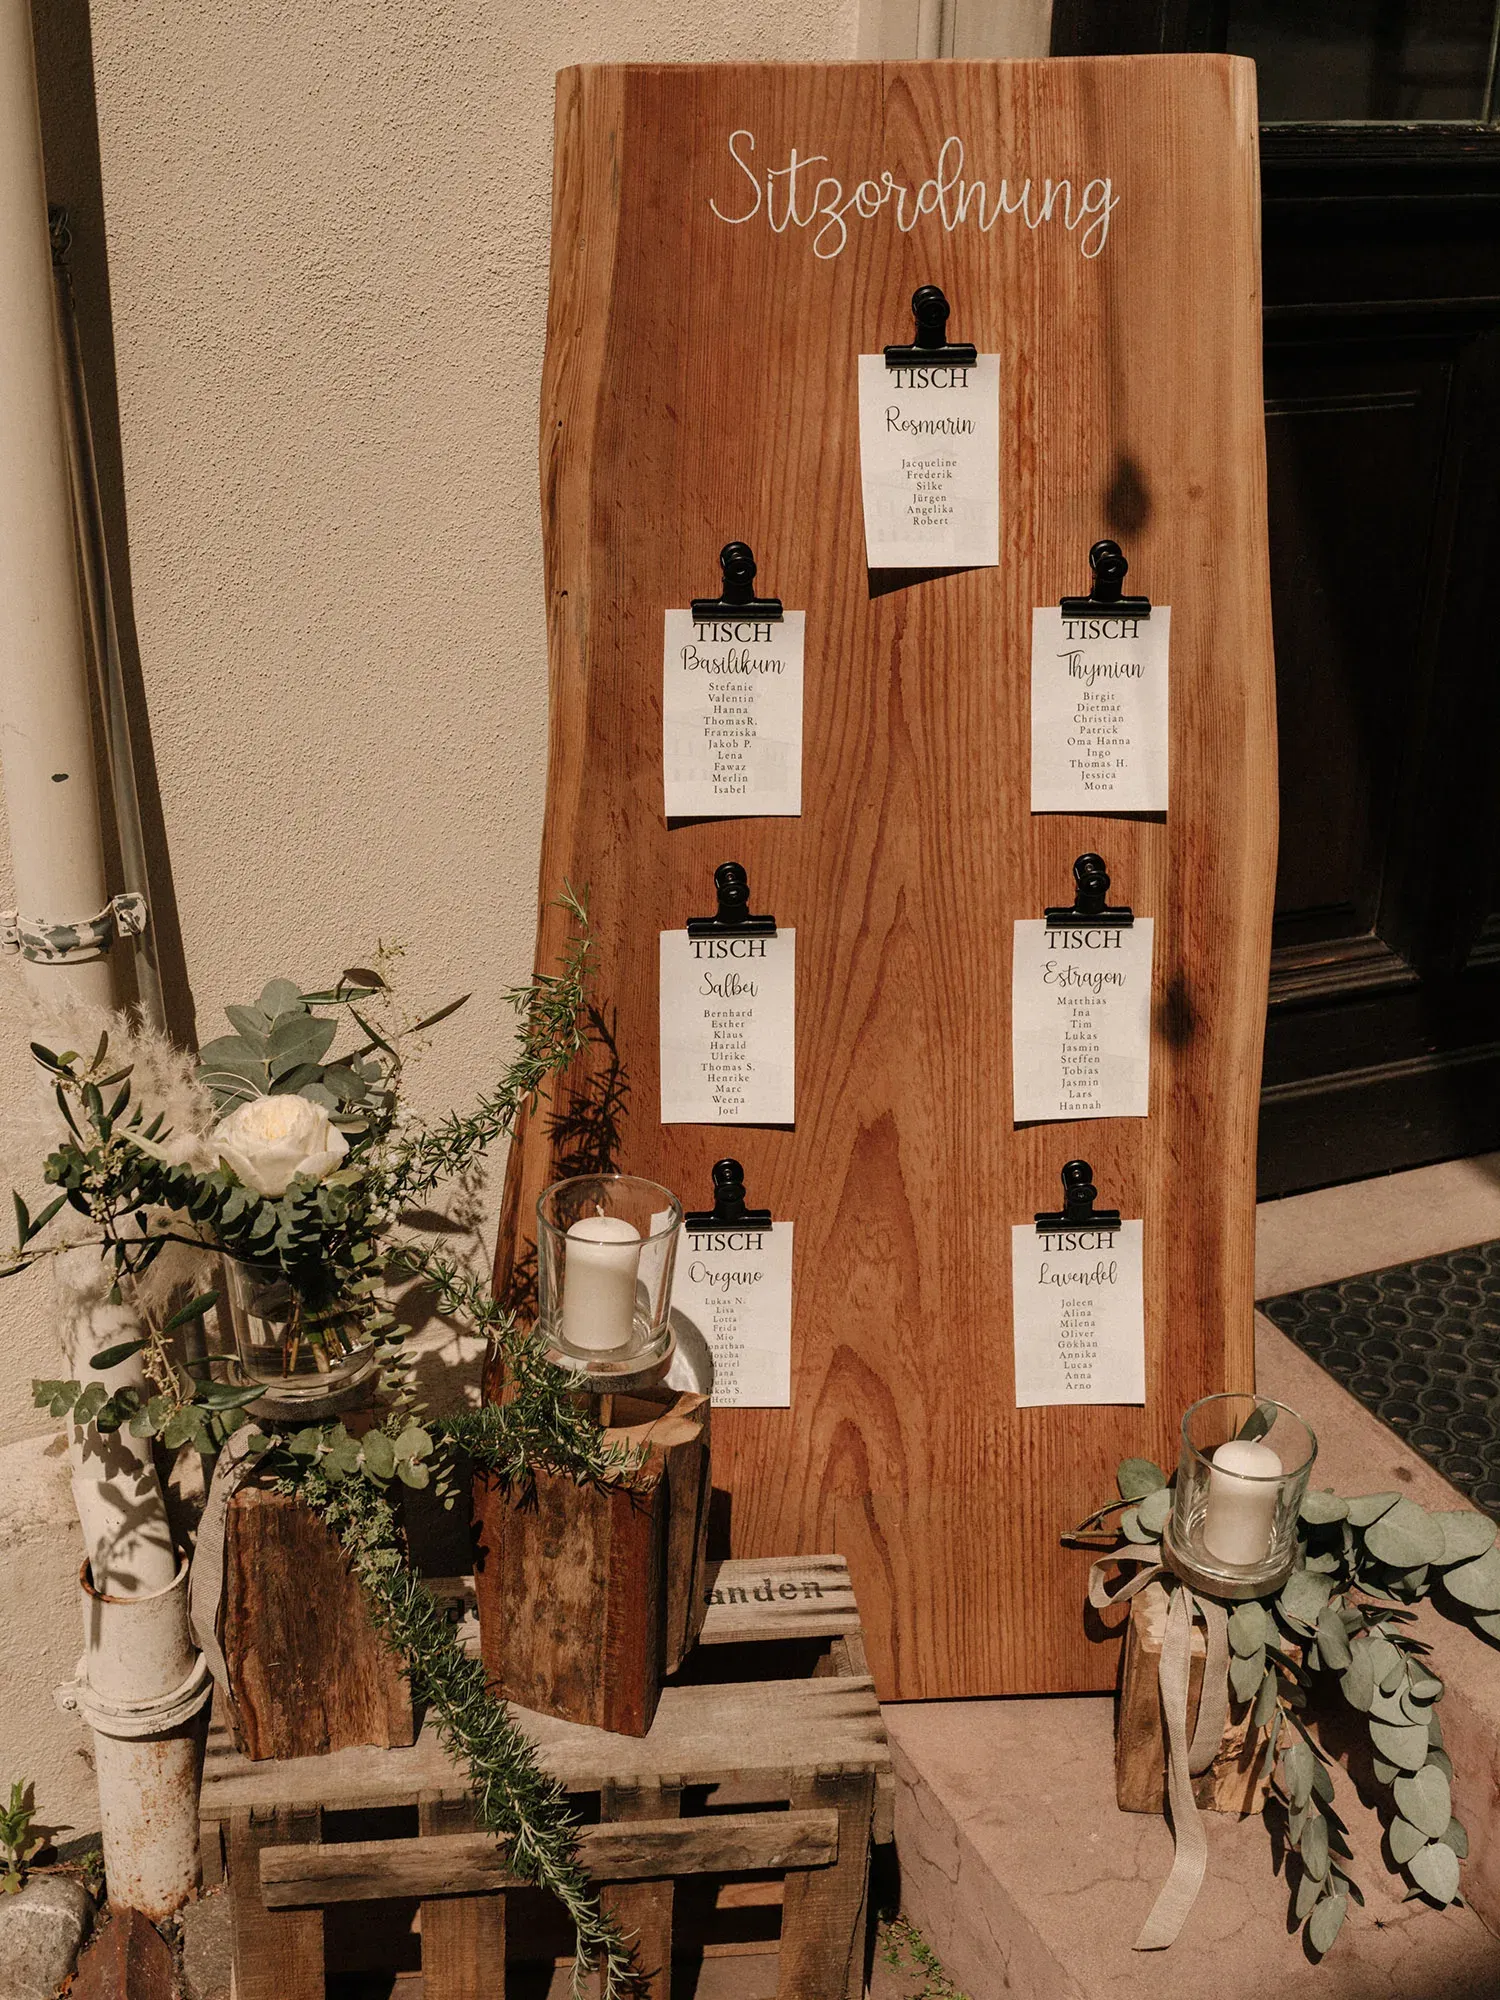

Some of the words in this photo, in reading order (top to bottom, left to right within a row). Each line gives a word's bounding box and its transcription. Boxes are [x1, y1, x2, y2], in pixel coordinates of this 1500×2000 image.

[710, 130, 1120, 259] Sitzordnung
[889, 368, 968, 389] TISCH
[885, 405, 976, 435] Rosmarin
[902, 459, 957, 471] Jacqueline
[907, 471, 952, 479] Frederik
[916, 482, 943, 491] Silke
[913, 494, 947, 504] Jürgen
[907, 505, 953, 515] Angelika
[912, 517, 948, 525] Robert
[693, 622, 773, 643] TISCH
[1062, 619, 1139, 640] TISCH
[680, 645, 786, 675] Basilikum
[1056, 650, 1145, 686] Thymian
[708, 682, 753, 691] Stefanie
[708, 694, 754, 703] Valentin
[1083, 692, 1115, 702] Birgit
[713, 706, 748, 714] Hanna
[1077, 703, 1121, 712] Dietmar
[1073, 715, 1124, 723] Christian
[704, 729, 757, 737] Franziska
[1079, 726, 1118, 734] Patrick
[708, 739, 739, 749] Jakob
[744, 740, 752, 748] P.
[1067, 737, 1092, 746] Oma
[1097, 737, 1131, 745] Hanna
[718, 752, 743, 760] Lena
[1087, 748, 1111, 759] Ingo
[714, 763, 746, 771] Fawaz
[1069, 760, 1111, 768] Thomas
[1116, 759, 1128, 767] H.
[712, 774, 748, 782] Merlin
[1081, 771, 1116, 780] Jessica
[714, 785, 746, 794] Isabel
[1084, 782, 1114, 791] Mona
[1044, 929, 1122, 949] TISCH
[689, 939, 767, 959] TISCH
[1040, 961, 1126, 994] Estragon
[699, 972, 759, 997] Salbei
[1057, 996, 1107, 1005] Matthias
[703, 1009, 753, 1017] Bernhard
[1073, 1008, 1090, 1017] Ina
[711, 1020, 745, 1028] Esther
[1070, 1020, 1092, 1028] Tim
[714, 1031, 744, 1039] Klaus
[1065, 1032, 1098, 1040] Lukas
[710, 1041, 746, 1050] Harald
[1062, 1043, 1100, 1052] Jasmin
[711, 1052, 745, 1060] Ulrike
[1060, 1055, 1100, 1064] Steffen
[701, 1063, 742, 1071] Thomas
[746, 1063, 755, 1071] S.
[1062, 1067, 1099, 1075] Tobias
[707, 1074, 750, 1082] Henrike
[1061, 1078, 1099, 1088] Jasmin
[715, 1085, 742, 1093] Marc
[1069, 1090, 1093, 1098] Lars
[712, 1096, 745, 1104] Weena
[1059, 1101, 1101, 1110] Hannah
[718, 1106, 739, 1116] Joel
[688, 1233, 763, 1252] TISCH
[1038, 1232, 1114, 1252] TISCH
[688, 1261, 764, 1292] Oregano
[1038, 1261, 1118, 1287] Lavendel
[1061, 1299, 1093, 1308] Joleen
[1063, 1310, 1092, 1318] Alina
[1060, 1320, 1096, 1328] Milena
[1061, 1330, 1094, 1338] Oliver
[705, 1343, 745, 1351] Jonathan
[1058, 1341, 1098, 1349] Gökhan
[1059, 1351, 1097, 1359] Annika
[709, 1360, 740, 1368] Muriel
[715, 1369, 734, 1377] Jana
[711, 1378, 738, 1387] Julian
[1065, 1382, 1092, 1390] Arno
[712, 1396, 737, 1404] Hetty
